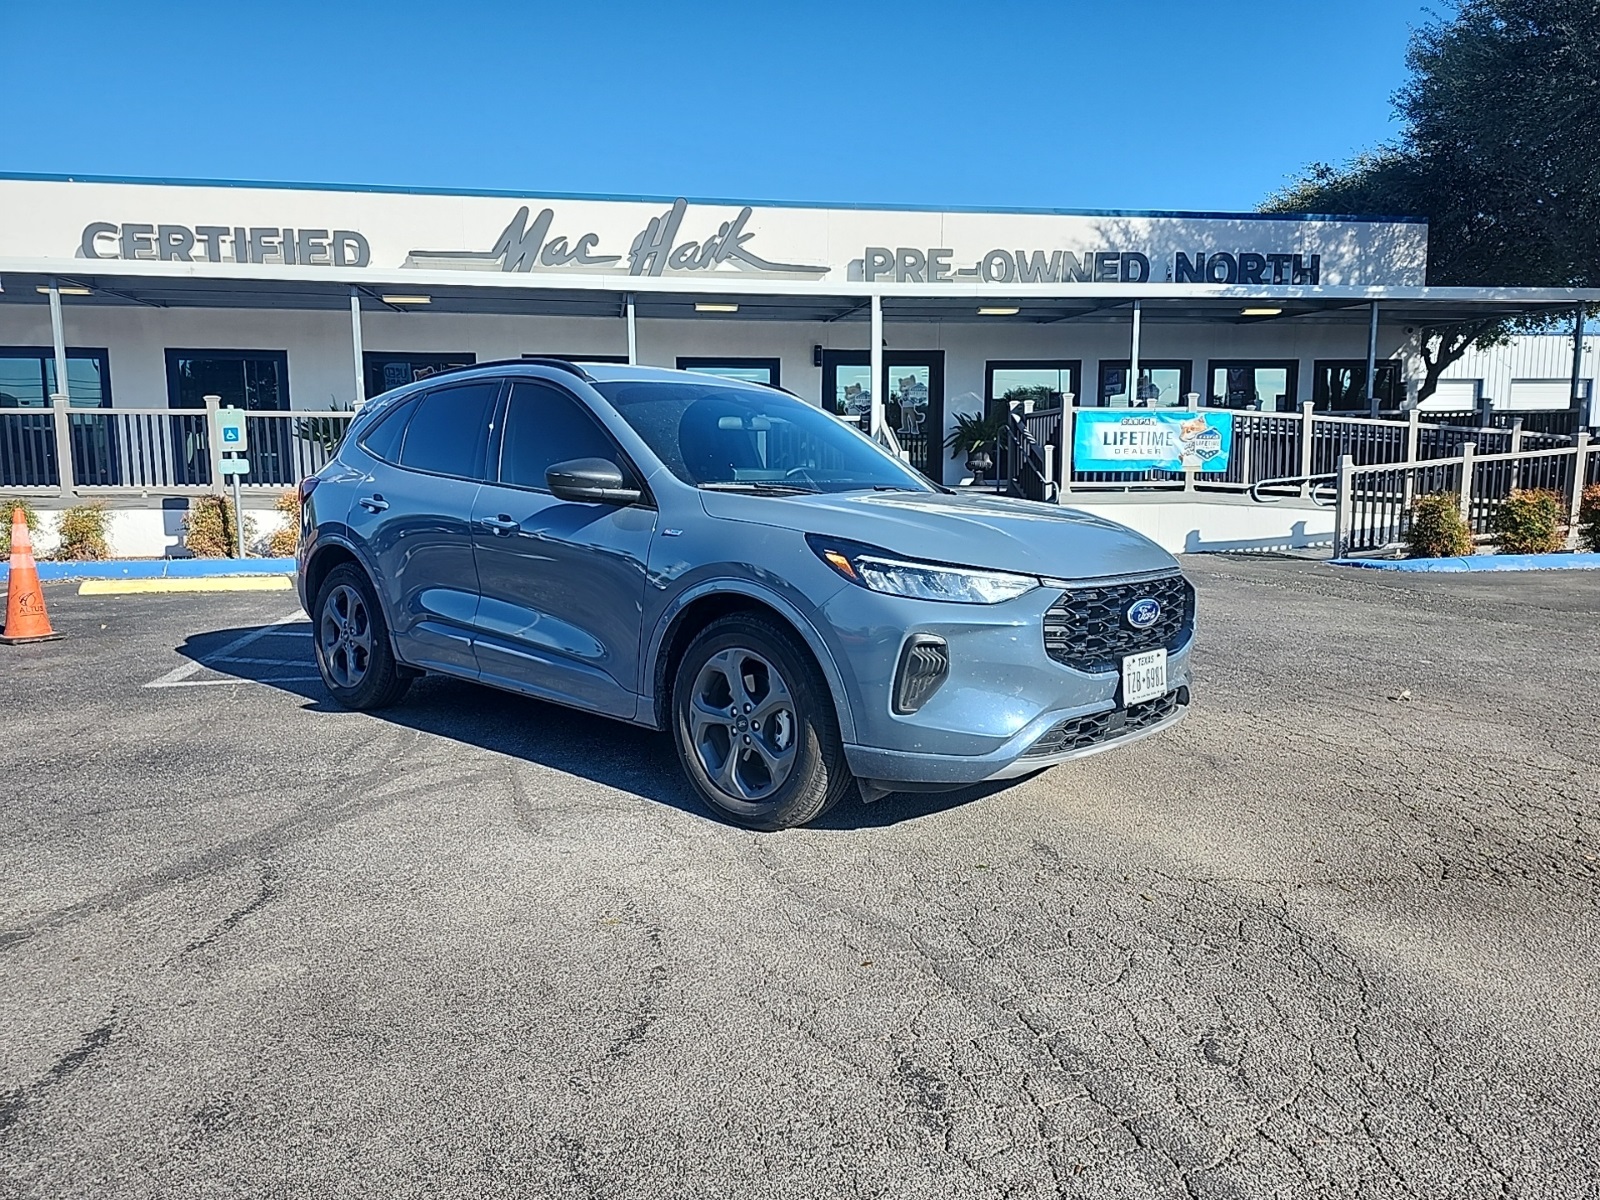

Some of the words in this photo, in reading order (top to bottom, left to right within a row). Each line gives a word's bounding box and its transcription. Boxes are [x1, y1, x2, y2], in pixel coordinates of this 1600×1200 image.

[81, 222, 370, 267] CERTIFIED
[409, 206, 622, 273] Mac
[629, 197, 831, 276] Haik
[864, 247, 1151, 283] PRE-OWNED
[1176, 251, 1320, 285] NORTH
[1103, 431, 1173, 446] LIFETIME
[1137, 605, 1156, 622] Ford
[1138, 655, 1154, 667] TEXAS
